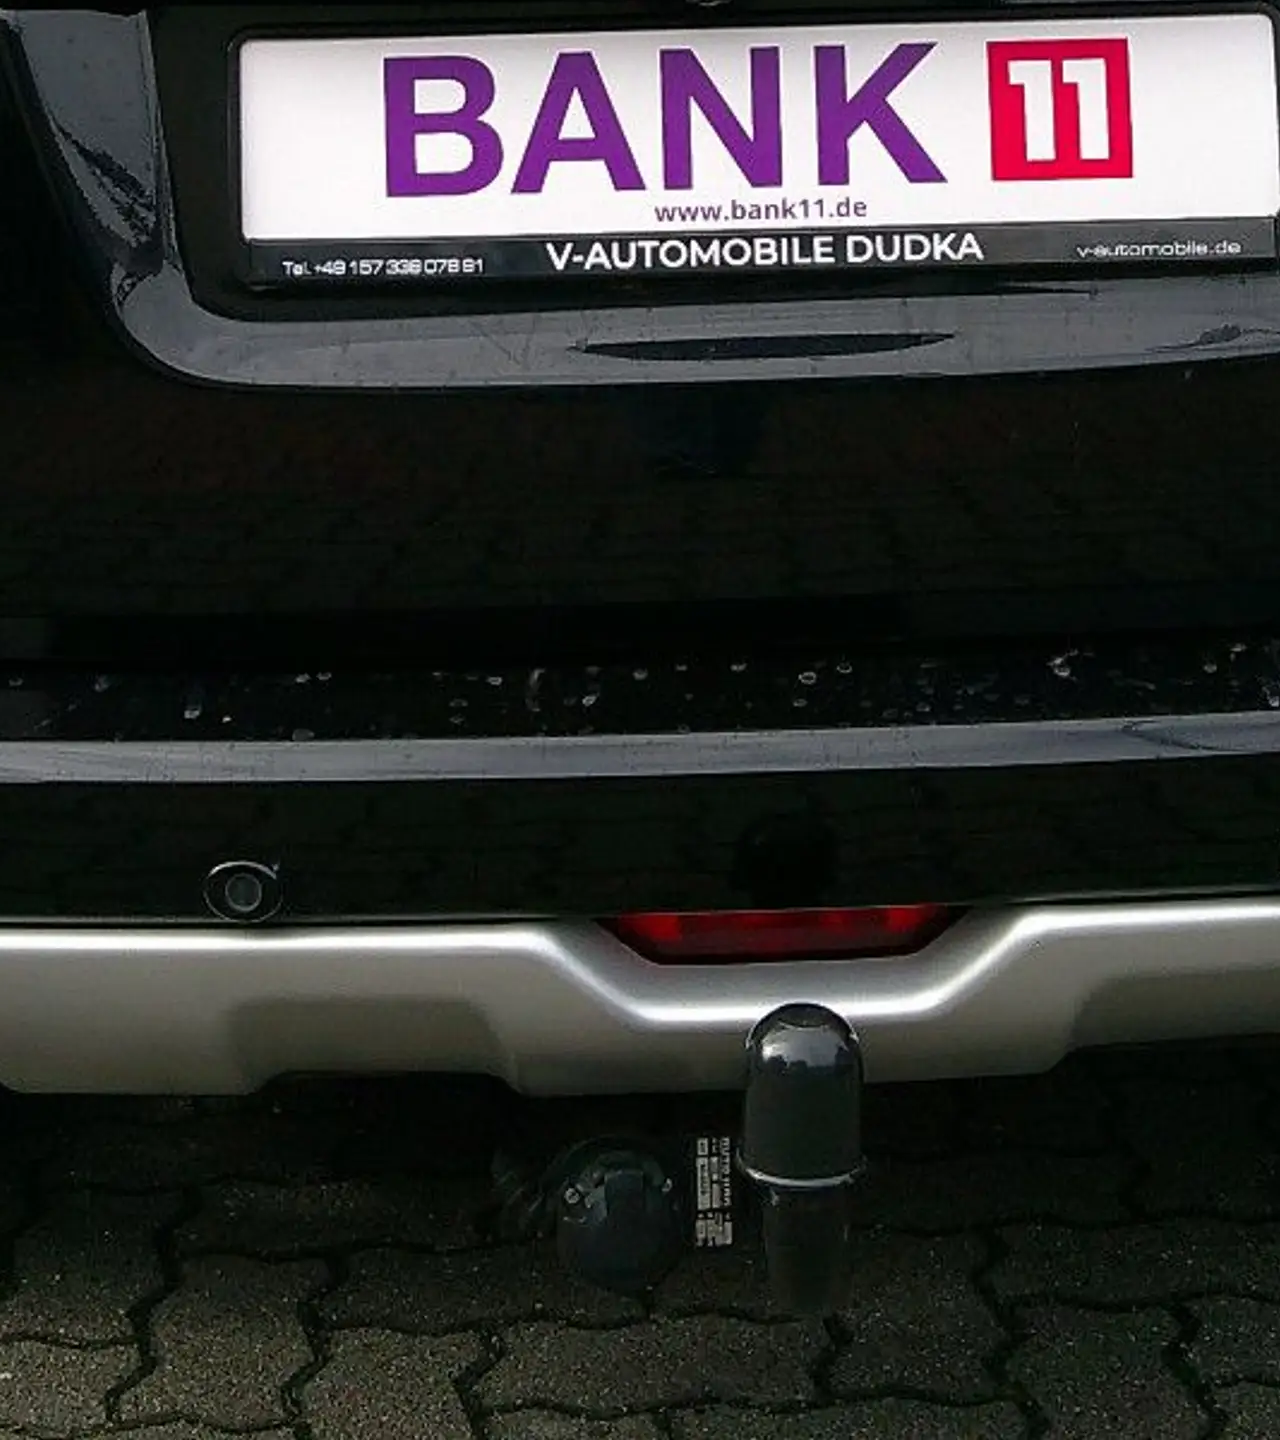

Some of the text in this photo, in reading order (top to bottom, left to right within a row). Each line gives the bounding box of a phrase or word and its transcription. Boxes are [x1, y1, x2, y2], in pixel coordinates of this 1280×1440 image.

[382, 40, 1112, 198] BANK 11
[654, 199, 868, 222] www.bank11.de
[546, 231, 985, 270] V-AUTOMOBILE DUDKA
[1076, 239, 1242, 258] v-automobile.de
